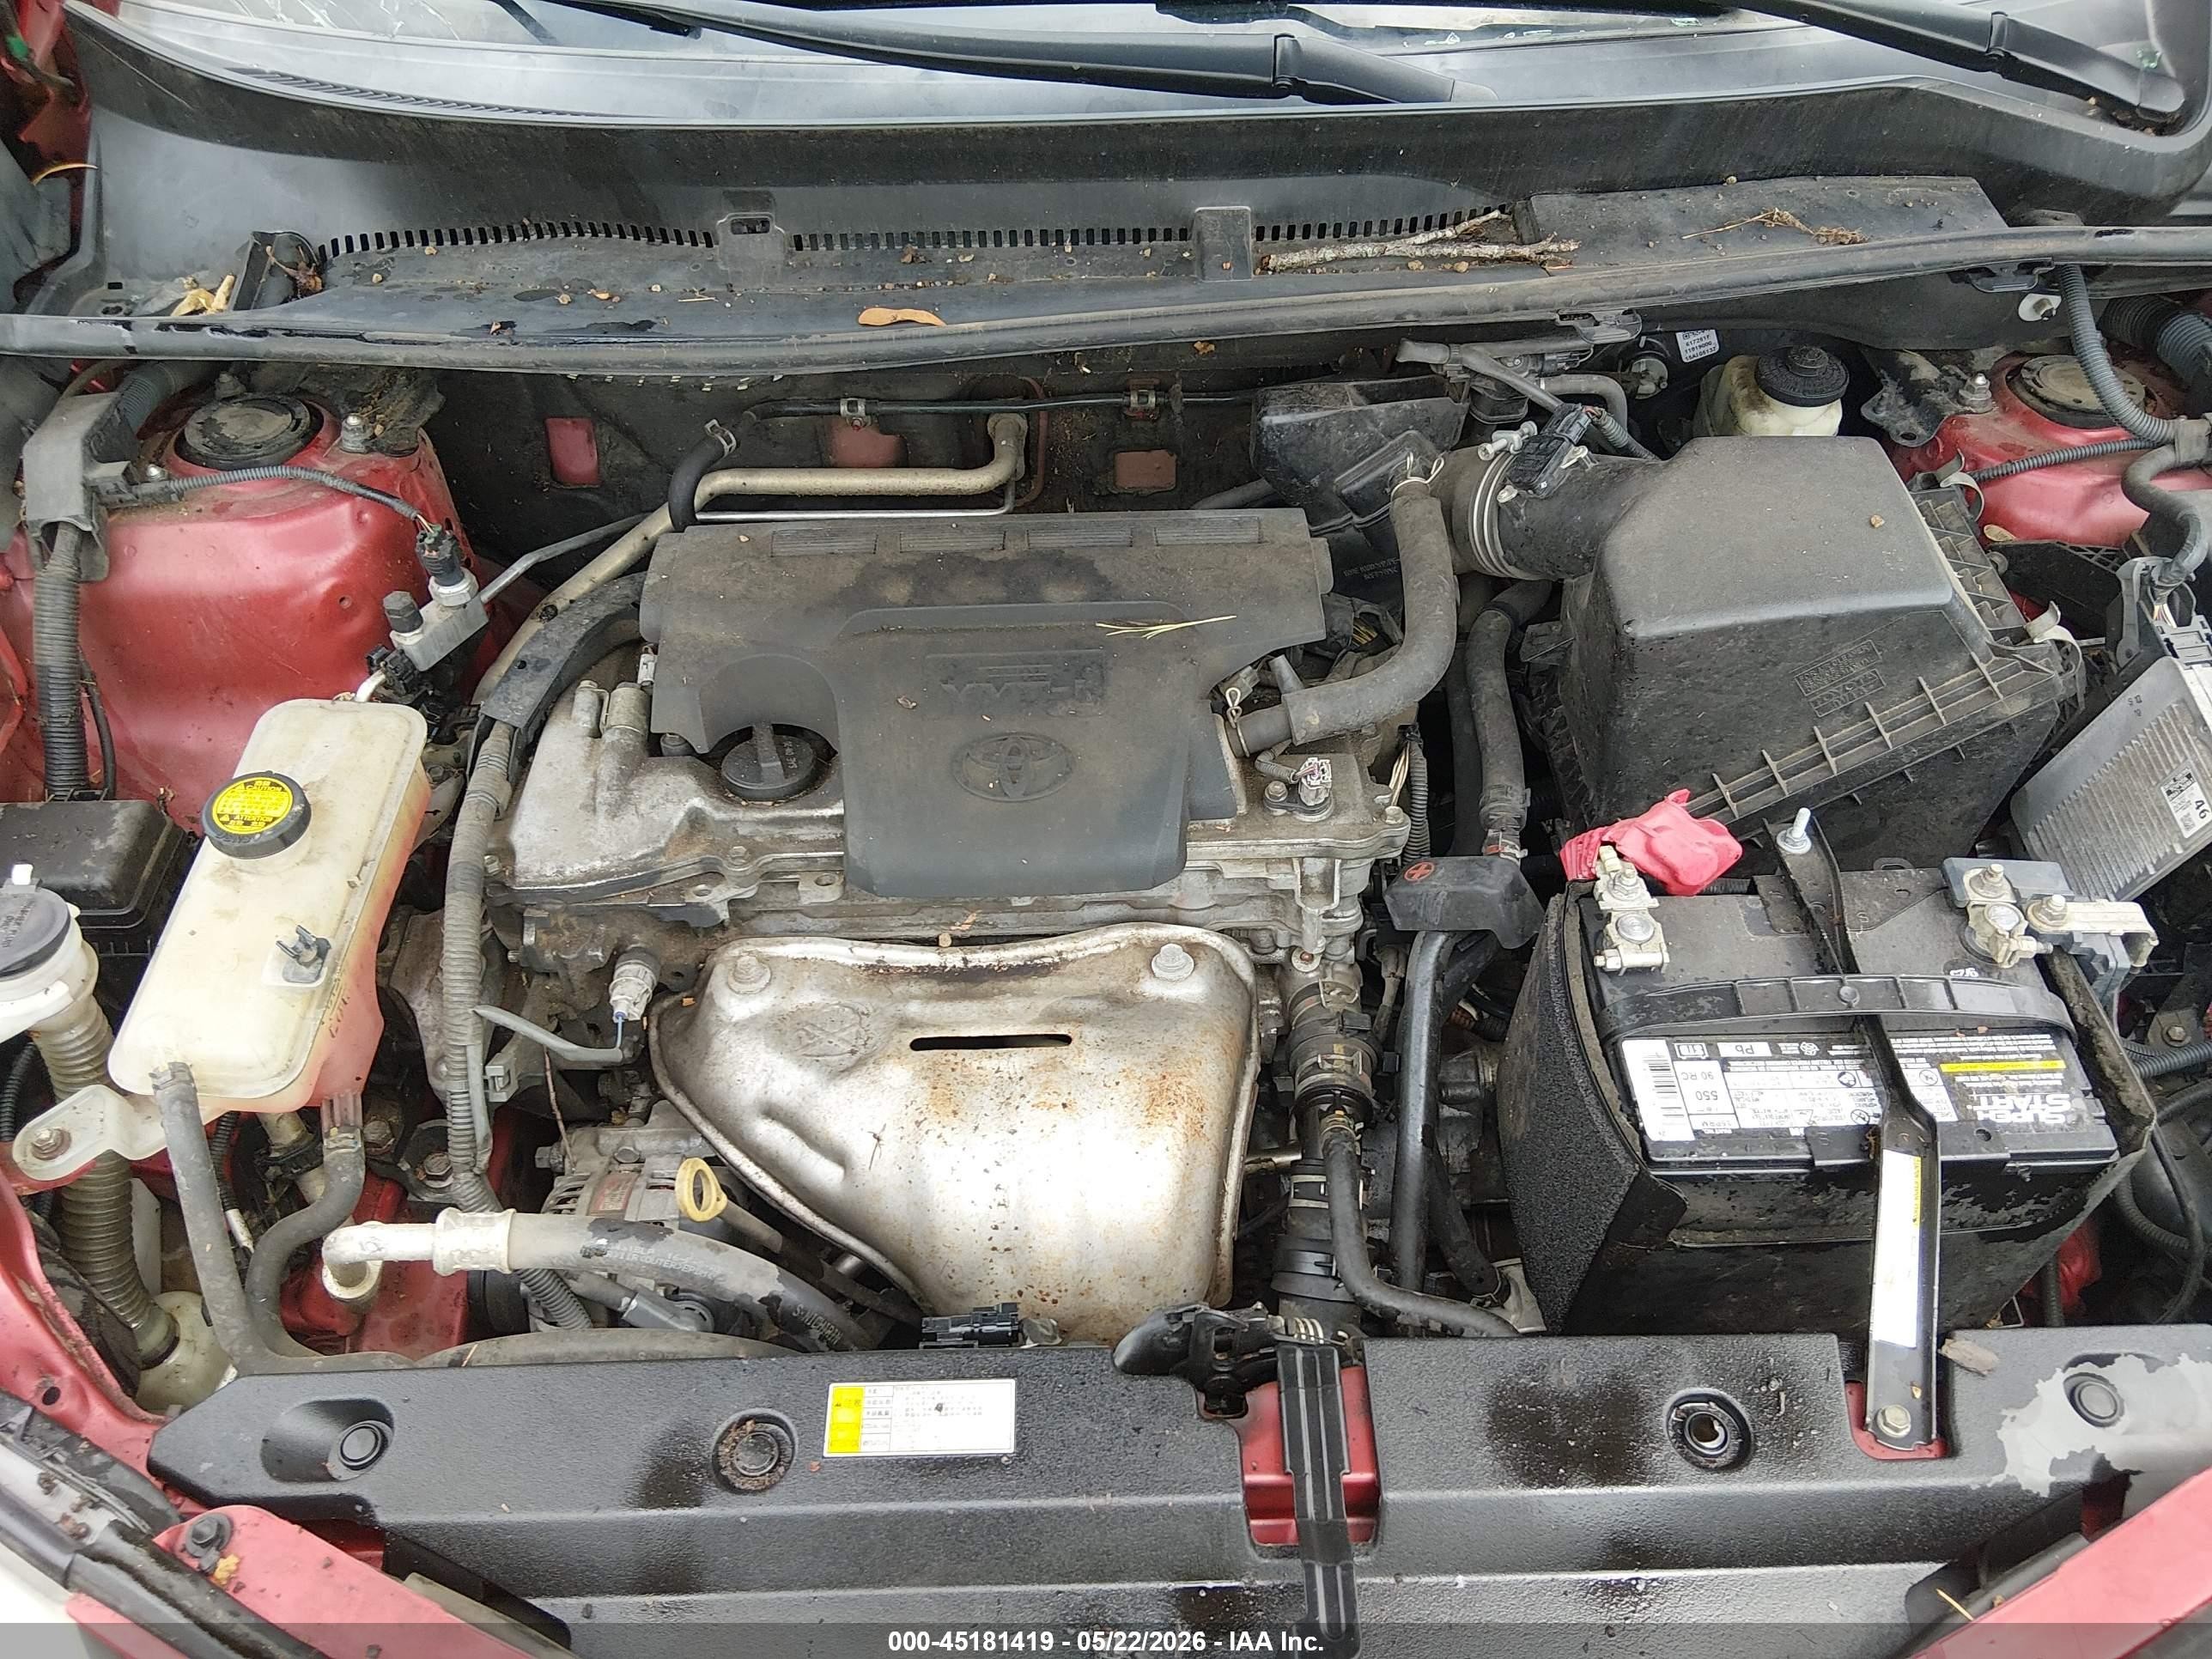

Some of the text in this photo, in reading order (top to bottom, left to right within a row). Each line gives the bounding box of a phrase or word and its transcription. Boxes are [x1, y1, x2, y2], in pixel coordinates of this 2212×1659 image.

[2195, 799, 2210, 819] 46
[1735, 1045, 1755, 1054] Pb
[1682, 1071, 1714, 1080] 90 RC
[1695, 1091, 1718, 1101] 550
[1973, 1093, 2072, 1111] START
[1977, 1109, 2066, 1124] SUPER
